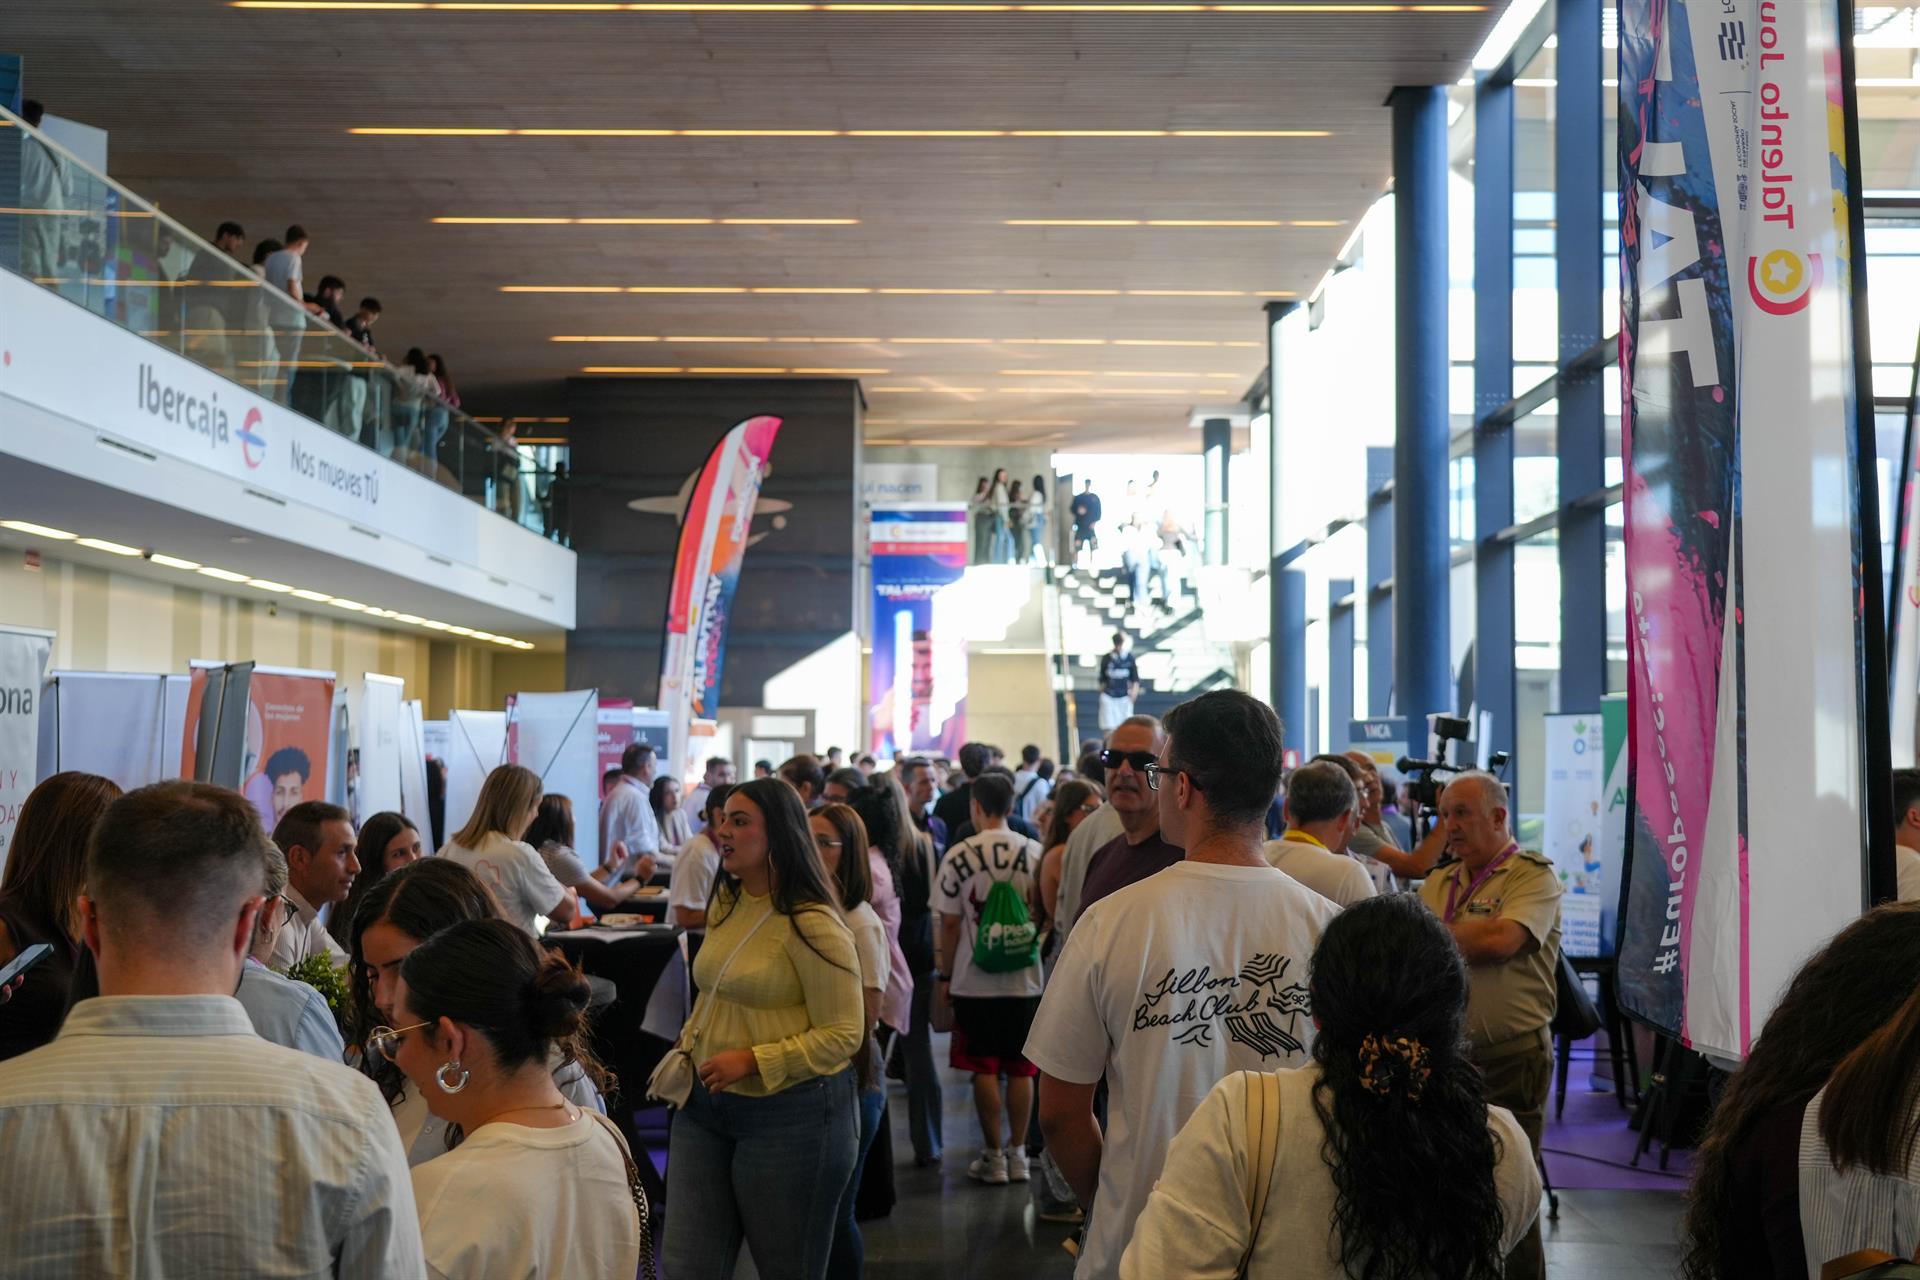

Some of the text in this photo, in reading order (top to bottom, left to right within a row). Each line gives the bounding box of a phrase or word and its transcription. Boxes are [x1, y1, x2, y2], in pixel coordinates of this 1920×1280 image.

[137, 363, 229, 449] Ibercaja
[291, 440, 380, 505] Nos mueves TÚ
[1363, 723, 1392, 738] YMCA
[9, 769, 18, 789] Y
[941, 842, 1029, 898] CHICA
[1133, 989, 1260, 1032] Beach Club
